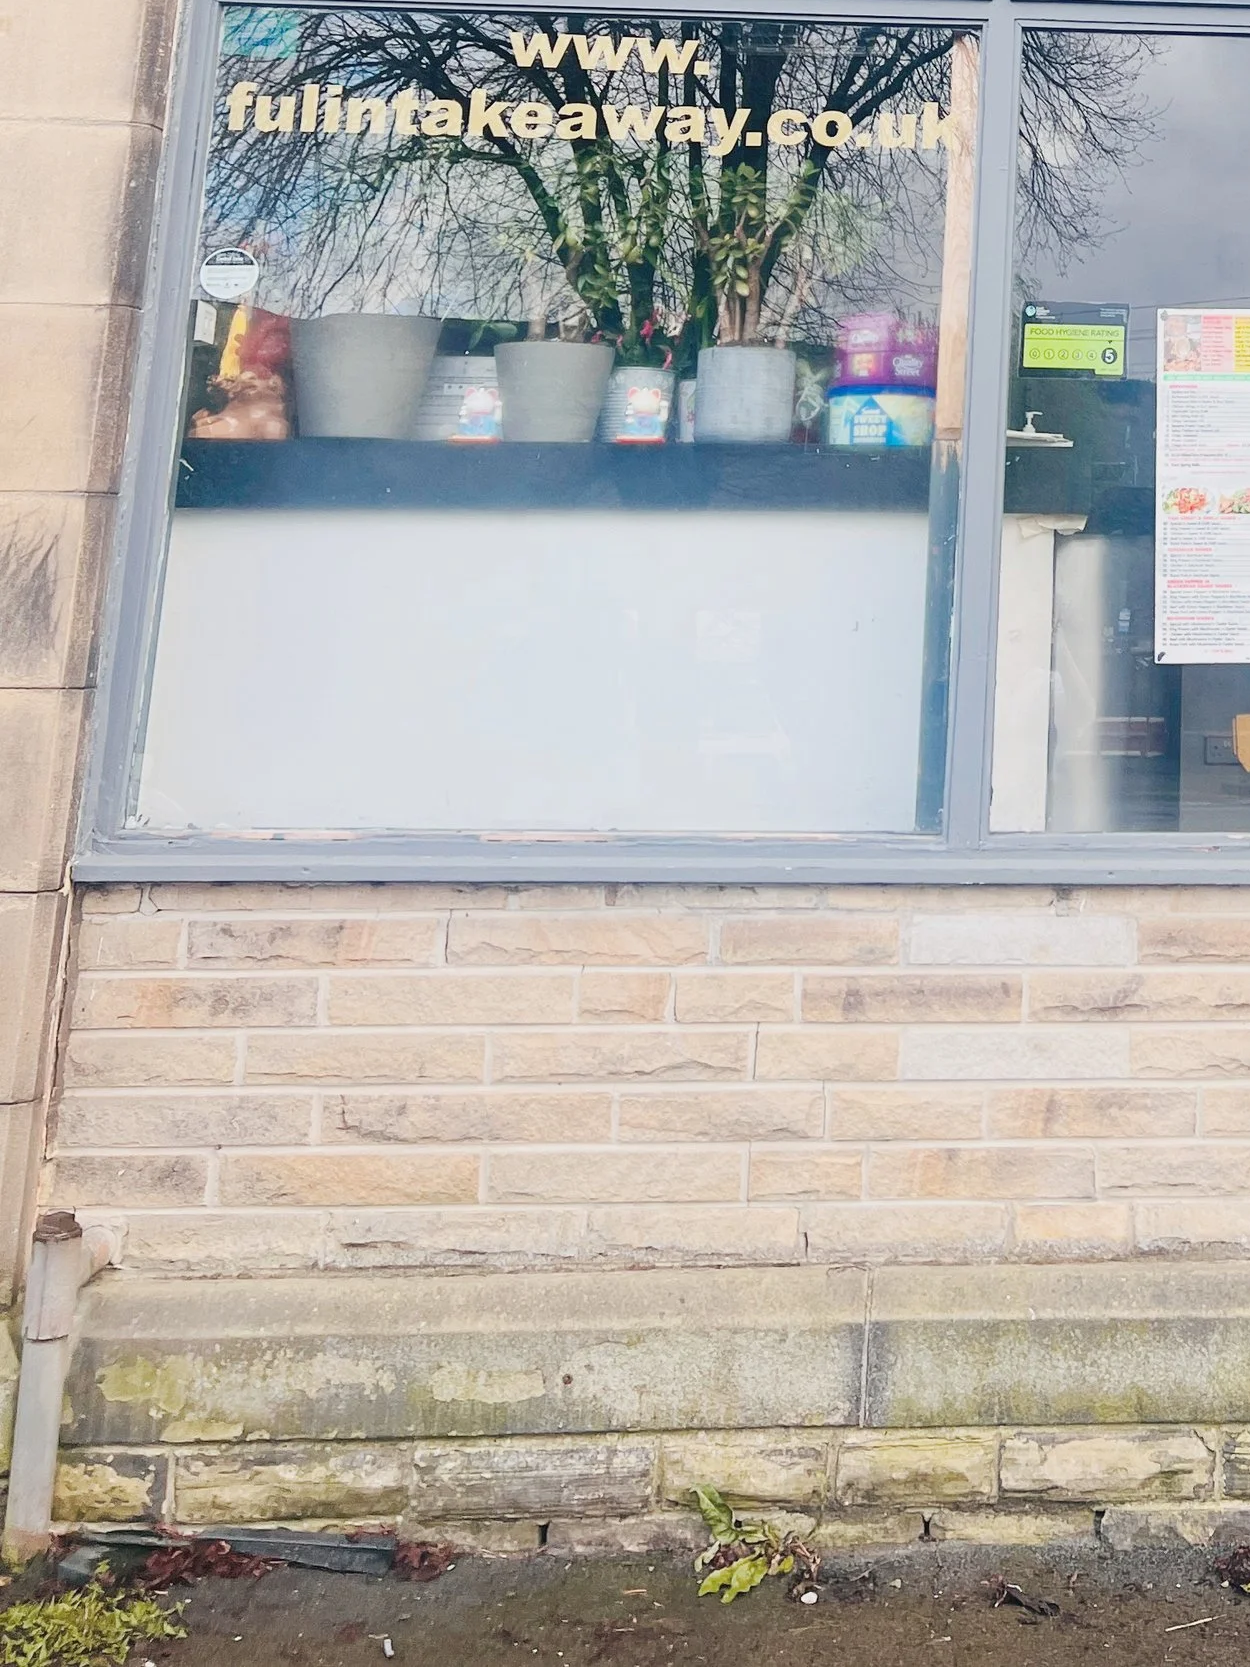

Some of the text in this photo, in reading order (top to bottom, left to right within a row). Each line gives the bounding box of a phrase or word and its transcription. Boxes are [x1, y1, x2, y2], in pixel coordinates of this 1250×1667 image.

[510, 31, 710, 76] www.
[226, 81, 958, 157] fulintakeaway.co.uk
[1029, 327, 1120, 337] FOOD HYGIENE RATING
[1104, 349, 1115, 363] 5
